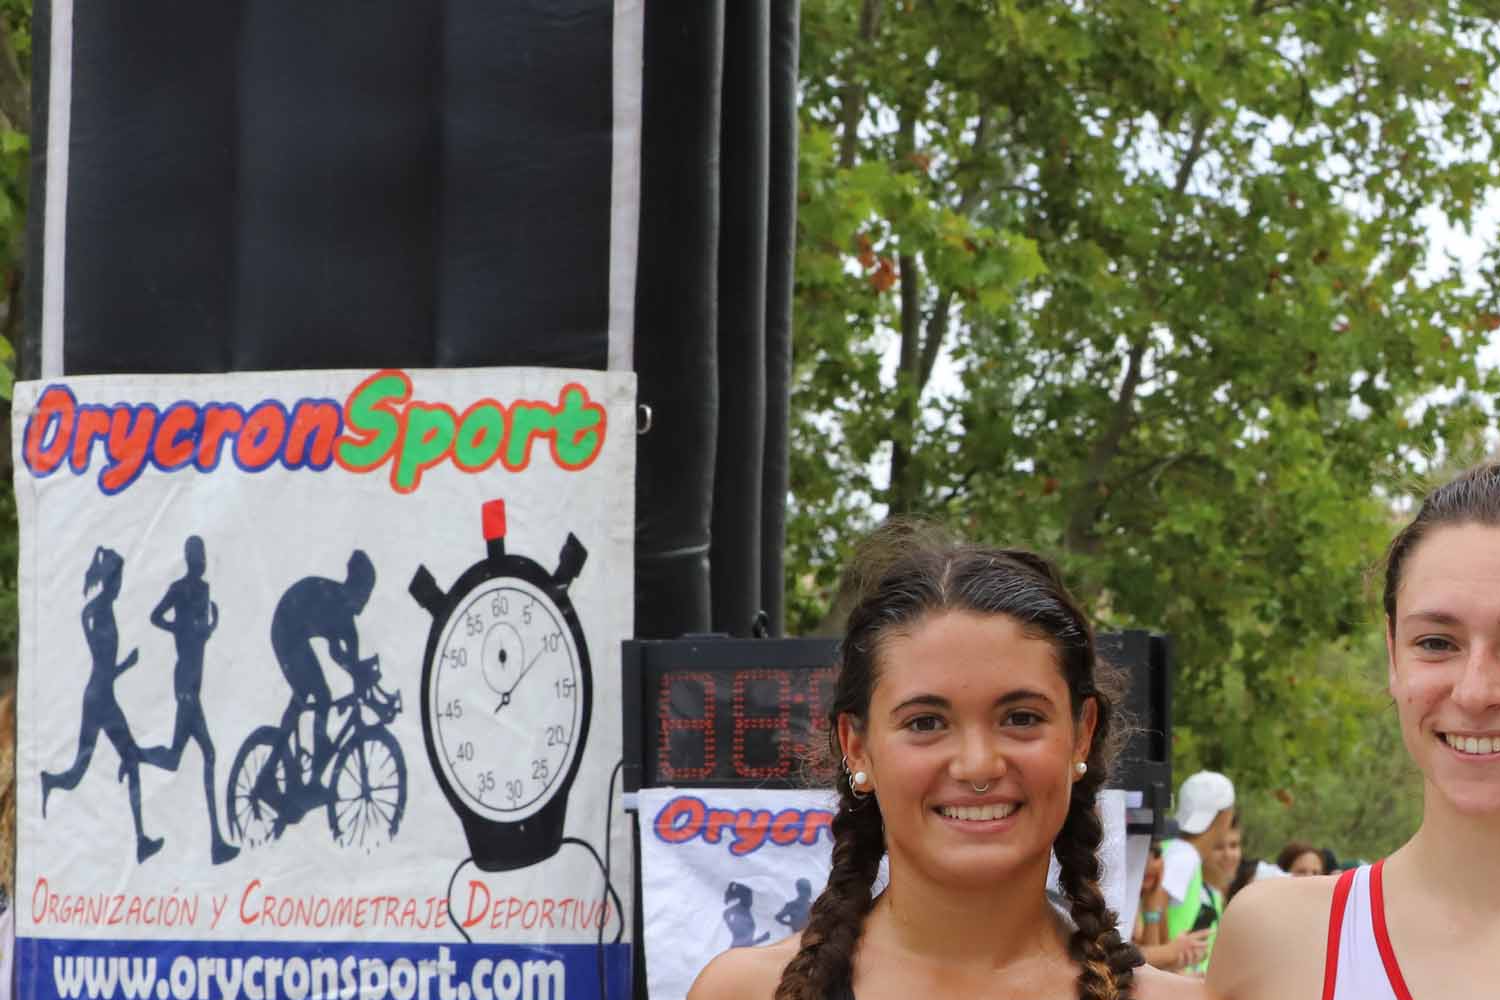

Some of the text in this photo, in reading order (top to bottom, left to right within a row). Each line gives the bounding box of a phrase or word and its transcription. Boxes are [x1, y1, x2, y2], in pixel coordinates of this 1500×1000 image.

[22, 368, 607, 496] OrycronSport
[491, 596, 509, 616] 60
[522, 605, 532, 625] 5
[466, 614, 484, 637] 55
[542, 633, 559, 653] 10
[449, 648, 468, 669] 50
[555, 678, 571, 698] 15
[445, 700, 463, 719] 45
[546, 725, 564, 747] 20
[456, 741, 475, 761] 40
[531, 760, 549, 780] 25
[477, 772, 495, 794] 35
[505, 779, 523, 801] 30
[654, 795, 836, 856] Orycr
[239, 878, 450, 929] CRONOMETRAJE
[462, 879, 613, 930] DEPORTIVO
